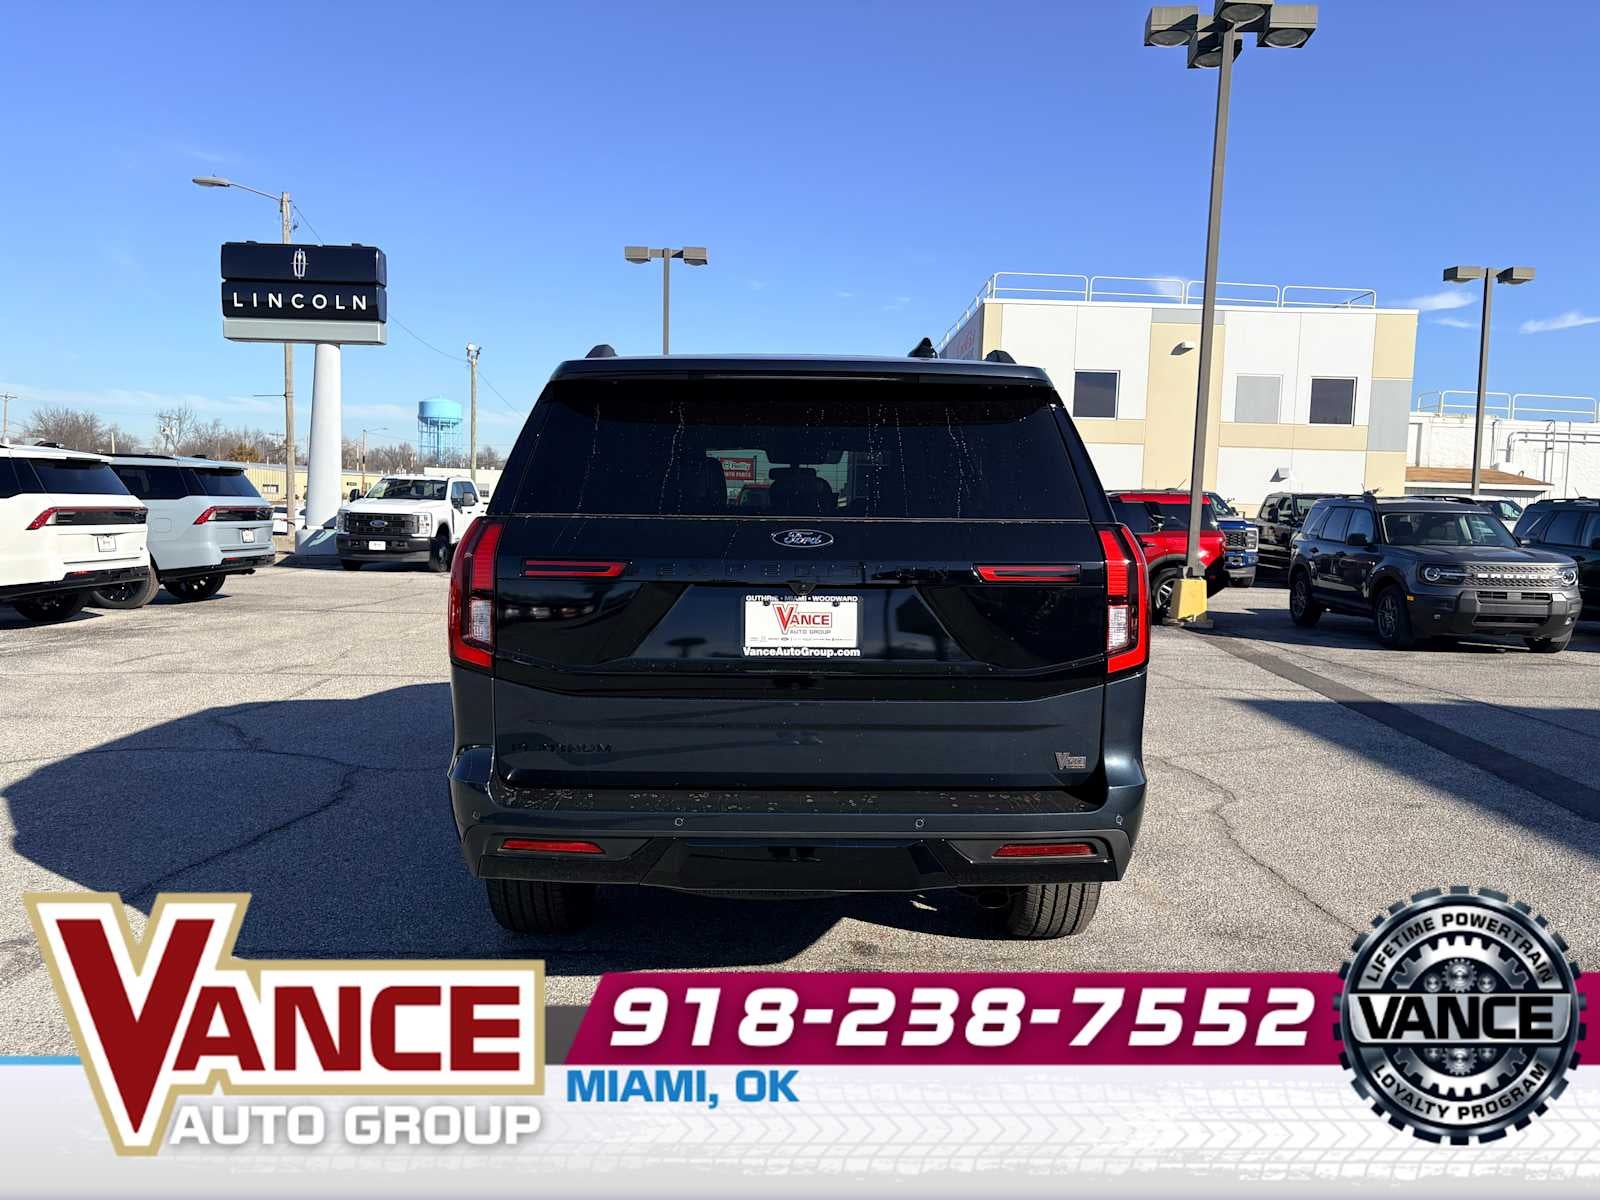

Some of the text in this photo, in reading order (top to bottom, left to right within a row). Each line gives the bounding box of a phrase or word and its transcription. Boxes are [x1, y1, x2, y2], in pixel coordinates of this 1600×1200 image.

[232, 292, 367, 311] LINCOLN
[781, 531, 824, 545] Ford
[774, 605, 831, 632] VANCE
[743, 646, 861, 658] VanceAutoGroup.com
